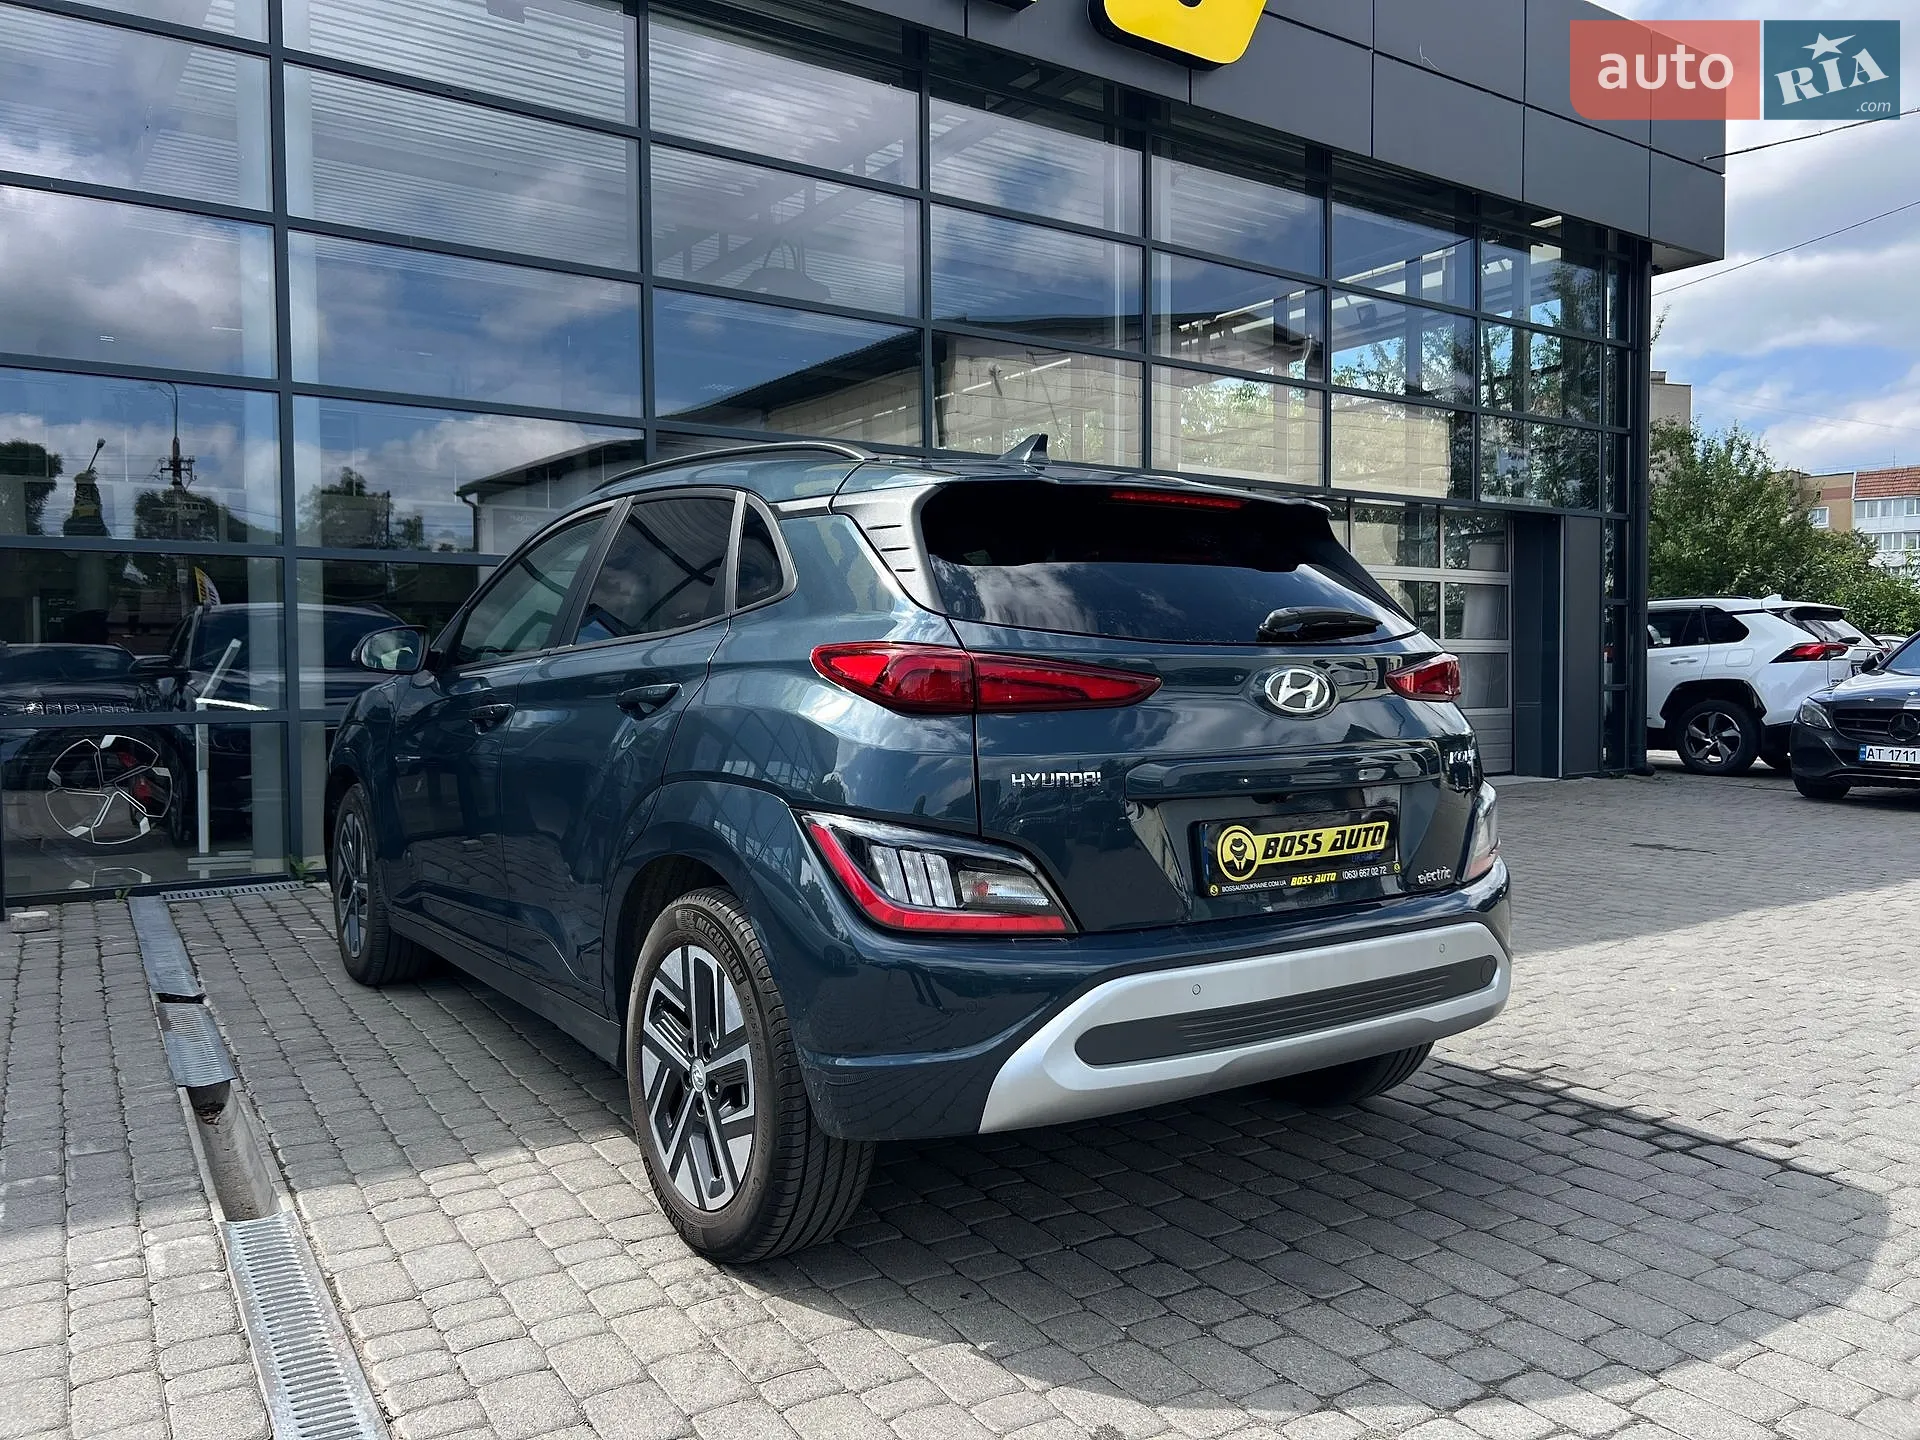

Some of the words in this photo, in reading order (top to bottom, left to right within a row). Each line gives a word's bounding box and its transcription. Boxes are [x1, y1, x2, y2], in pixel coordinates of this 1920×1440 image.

[1867, 747, 1884, 760] AT
[1888, 749, 1916, 763] 1711
[1011, 771, 1101, 788] HYUNDAI
[1262, 832, 1323, 860] BOSS
[1328, 824, 1386, 852] AUTO
[1290, 875, 1313, 887] BOSS
[1314, 872, 1337, 884] AUTO
[695, 917, 744, 981] MICHELIN
